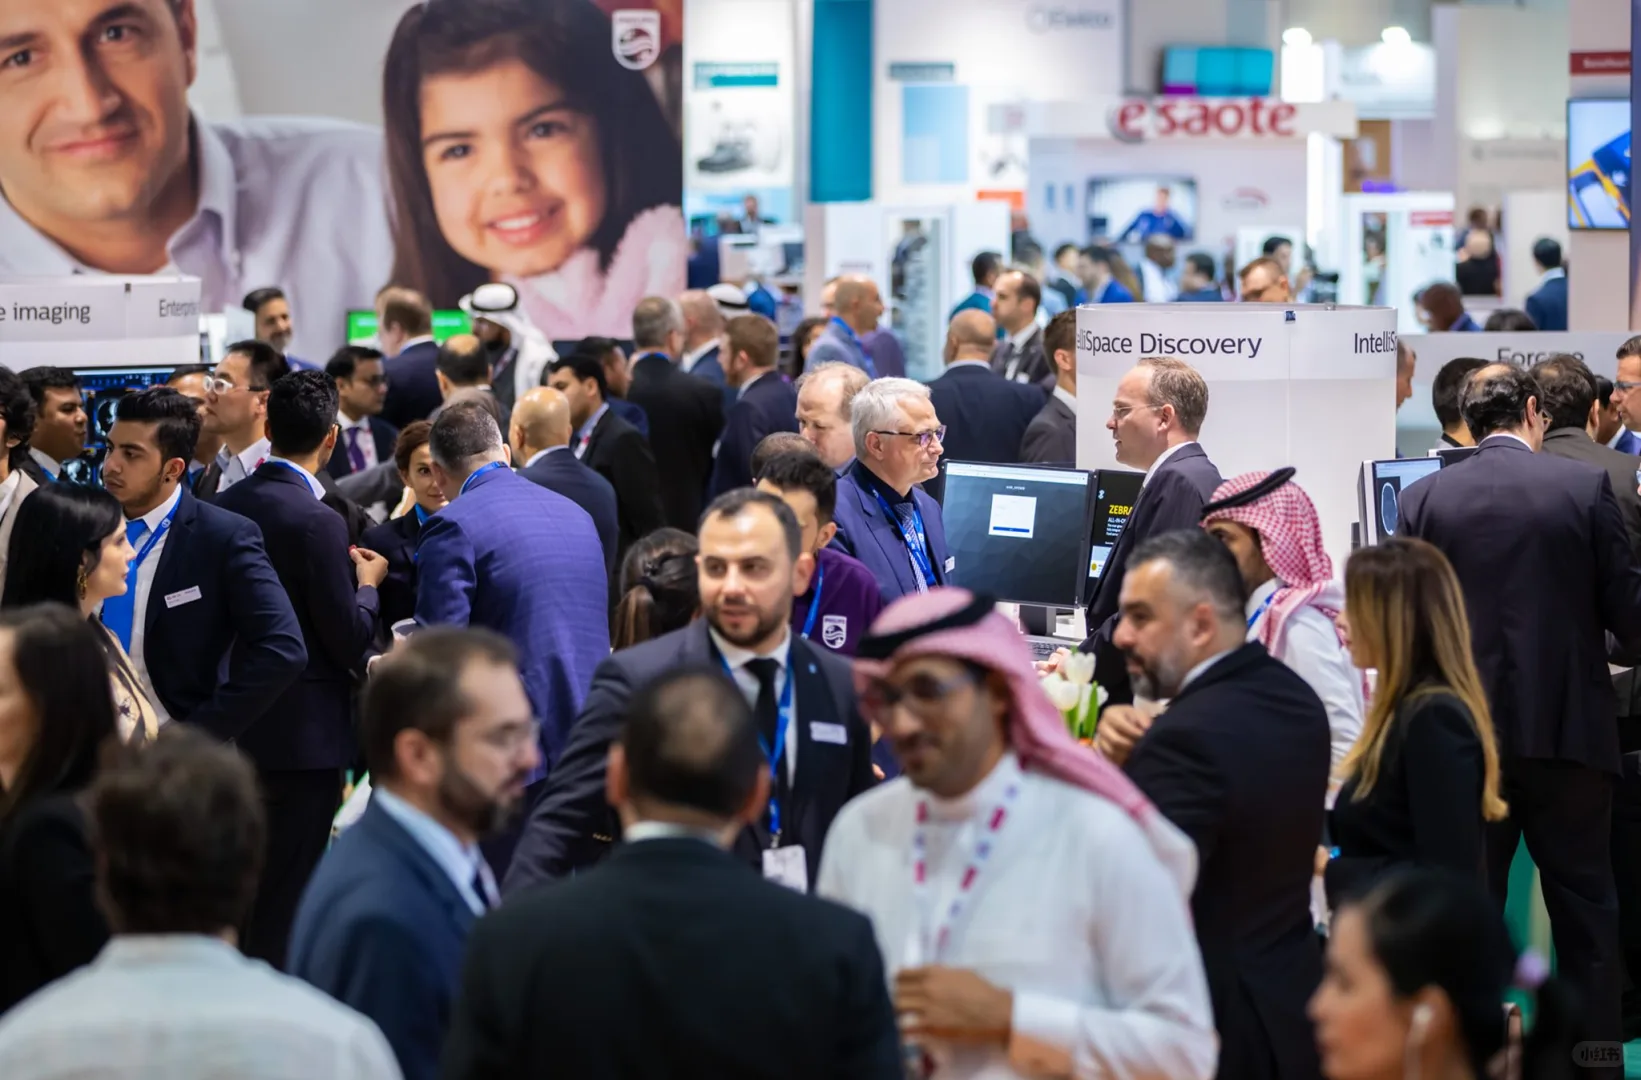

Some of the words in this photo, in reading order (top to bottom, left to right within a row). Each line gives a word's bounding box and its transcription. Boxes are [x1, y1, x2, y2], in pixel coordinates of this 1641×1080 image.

[1117, 97, 1297, 136] esaote
[13, 302, 91, 324] imaging
[1140, 333, 1262, 358] Discovery
